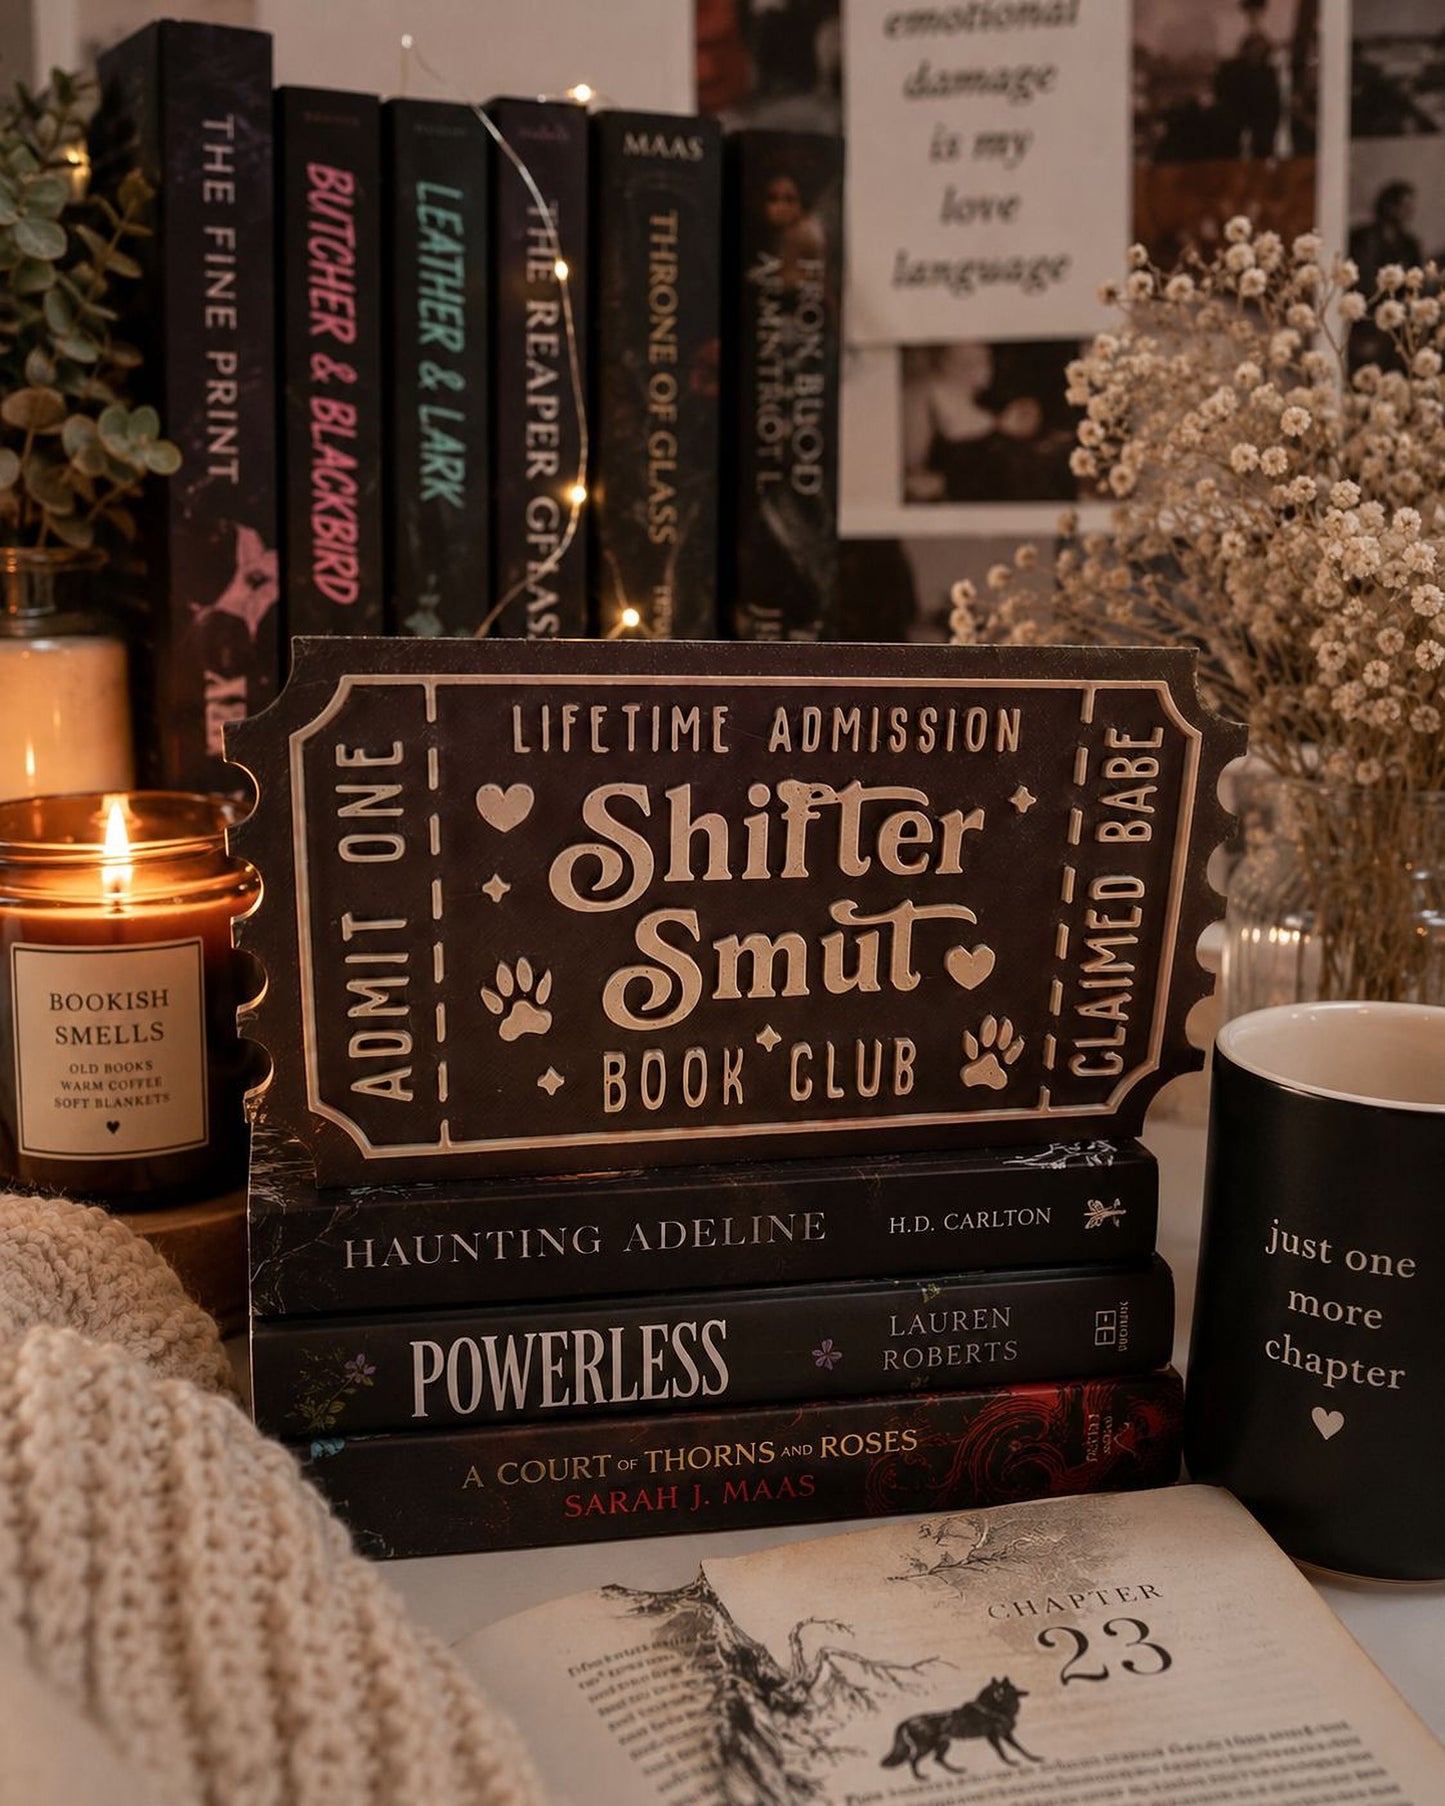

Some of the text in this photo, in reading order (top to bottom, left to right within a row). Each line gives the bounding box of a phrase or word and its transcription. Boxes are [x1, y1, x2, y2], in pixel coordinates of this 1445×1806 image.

[884, 0, 1080, 39] emotional
[903, 58, 1057, 106] damage
[622, 131, 704, 162] MAAS
[929, 121, 1034, 170] is my
[939, 184, 1021, 225] love
[307, 162, 357, 344] BUTCHER
[416, 181, 466, 353] LEATHER
[526, 200, 560, 284] THE
[891, 247, 1072, 299] language
[203, 114, 240, 485] THE FINE PRINT
[310, 353, 358, 384] &
[418, 361, 466, 391] &
[526, 300, 560, 480] REAPER
[649, 208, 679, 545] THRONE OF GLASS
[418, 404, 466, 508] LARK
[310, 396, 360, 605] BLACKBIRD
[512, 704, 1022, 754] LIFETIME ADMISSION
[548, 779, 985, 912] Shifter
[335, 740, 414, 1102] ADMIT ONE
[1068, 726, 1165, 1077] CLAIMED BABE
[602, 899, 978, 1031] Smut
[49, 988, 170, 1012] BOOKISH
[55, 1021, 165, 1046] SMELLS
[61, 1080, 103, 1092] WARM
[69, 1060, 153, 1075] OLD BOOKS
[602, 1036, 918, 1113] BOOK CLUB
[54, 1093, 171, 1110] SOFT BLANKETS
[342, 1210, 828, 1271] HAUNTING ADELINE
[888, 1207, 1054, 1235] H.D. CARLTON
[1265, 1218, 1418, 1279] just one
[889, 1306, 1013, 1338] LAUREN
[1287, 1289, 1384, 1330] more
[409, 1319, 731, 1419] POWERLESS
[881, 1340, 1020, 1372] ROBERTS
[1265, 1333, 1407, 1390] chapter
[461, 1428, 919, 1490] A COURT OF THORNS AND ROSES
[564, 1473, 816, 1519] SARAH J. MAAS
[987, 1583, 1165, 1621] CHAPTER
[1036, 1616, 1174, 1687] 23
